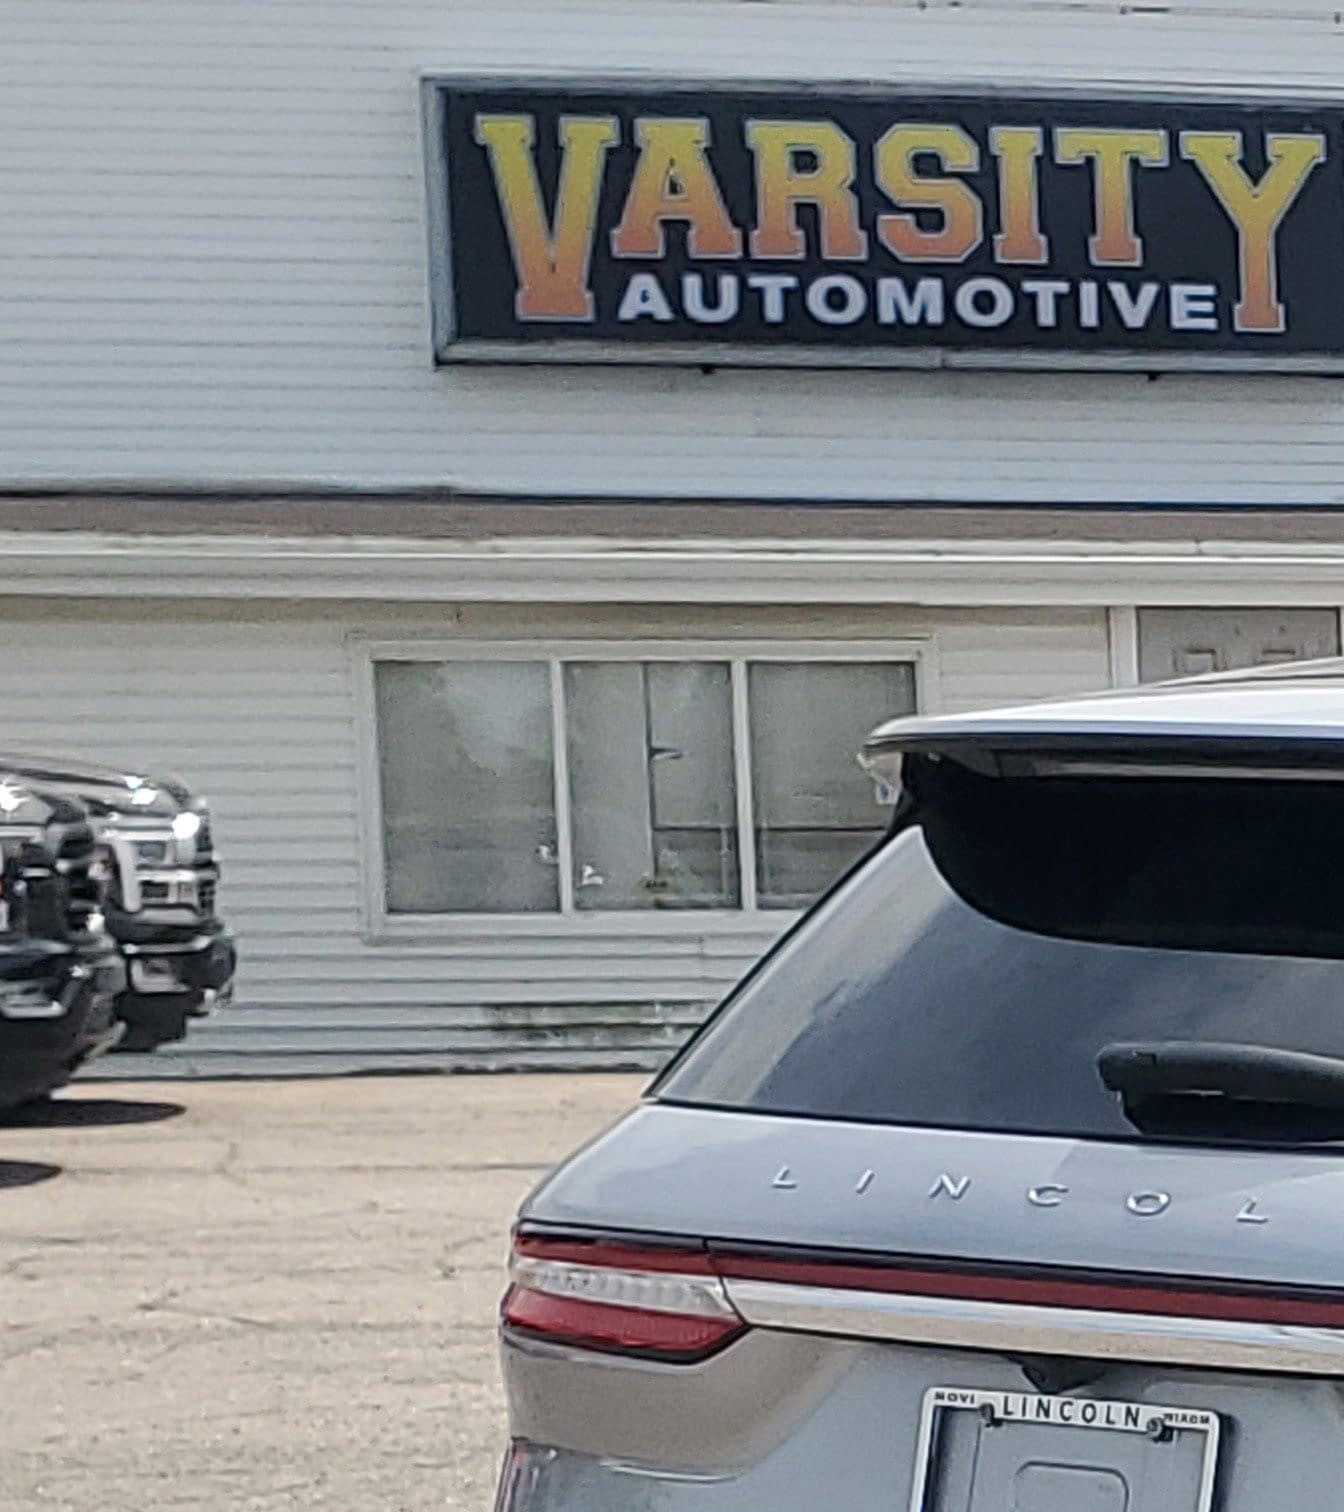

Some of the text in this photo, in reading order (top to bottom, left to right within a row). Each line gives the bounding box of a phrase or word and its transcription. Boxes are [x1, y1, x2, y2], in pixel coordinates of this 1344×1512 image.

[473, 113, 1328, 334] VARSITY
[616, 272, 1219, 332] AUTOMOTIVE
[1002, 1394, 1140, 1428] LINCOLN
